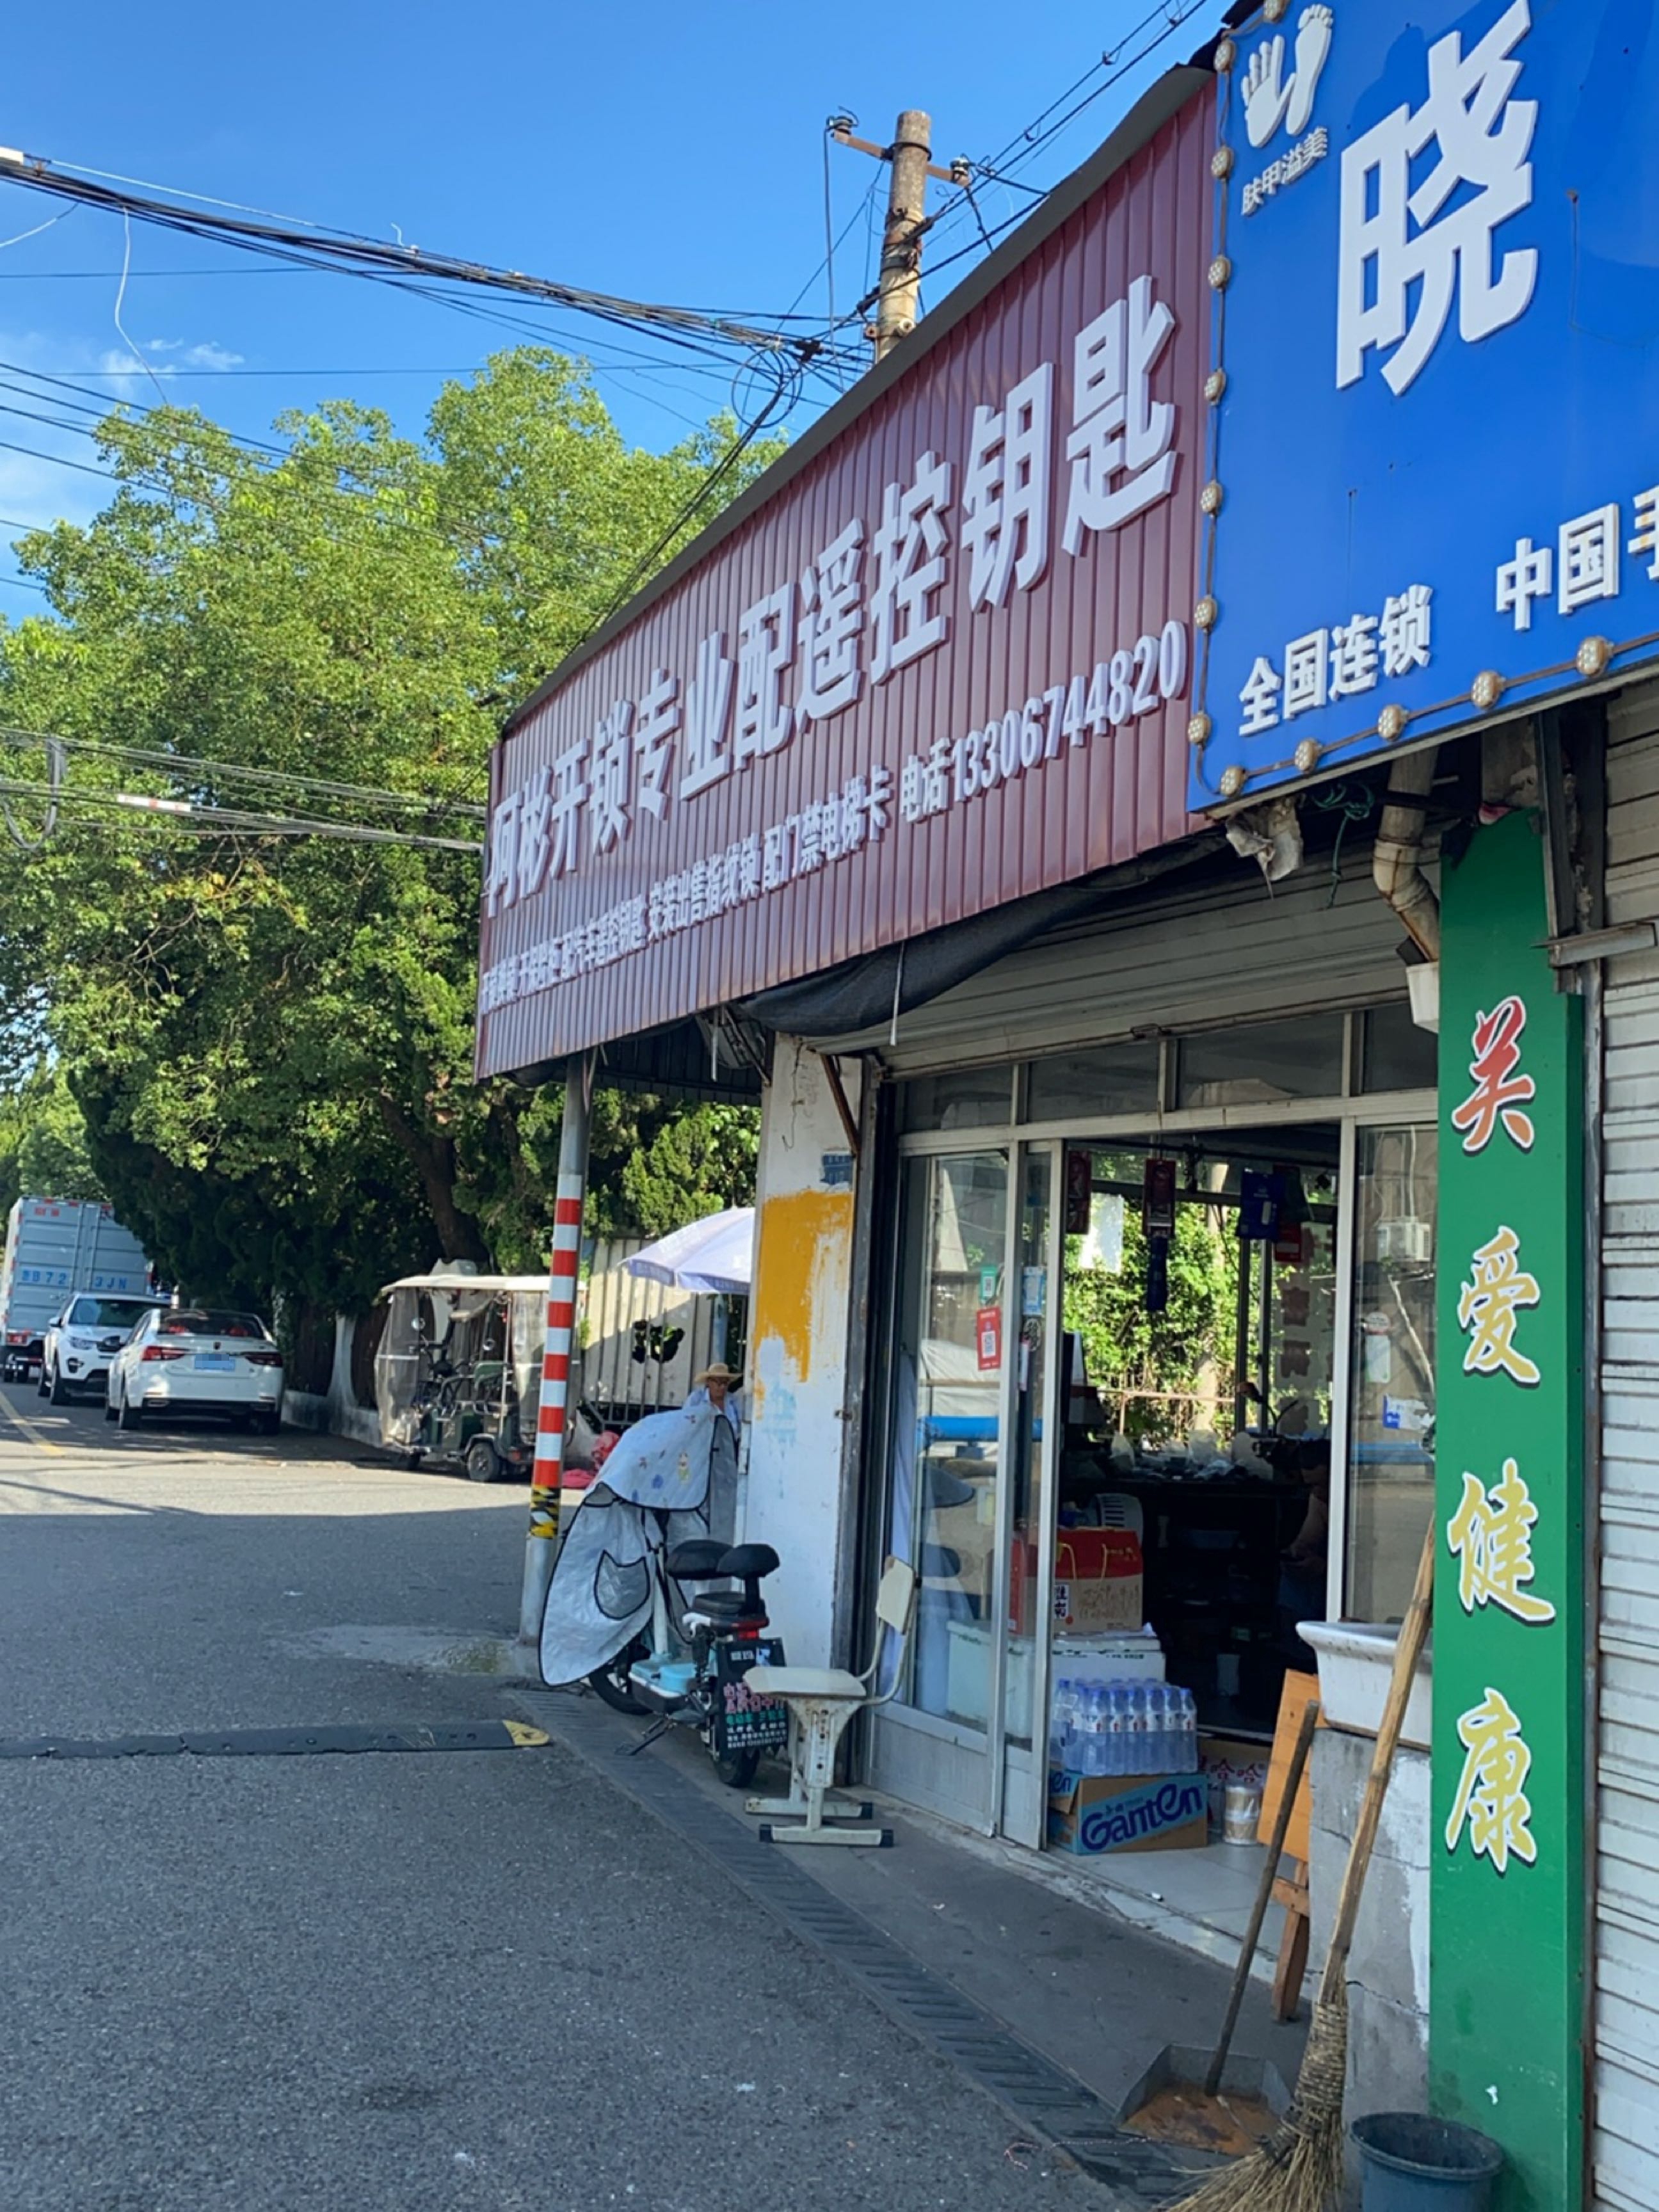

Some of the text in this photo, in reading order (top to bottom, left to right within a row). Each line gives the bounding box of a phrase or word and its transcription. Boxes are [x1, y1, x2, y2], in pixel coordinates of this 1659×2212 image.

[1241, 126, 1327, 215] 肤甲溢美
[1336, 0, 1538, 396] 晓
[1238, 582, 1433, 737] 全国连锁
[760, 764, 892, 892] 配门禁电梯卡
[1445, 994, 1555, 1872] 关爱健康
